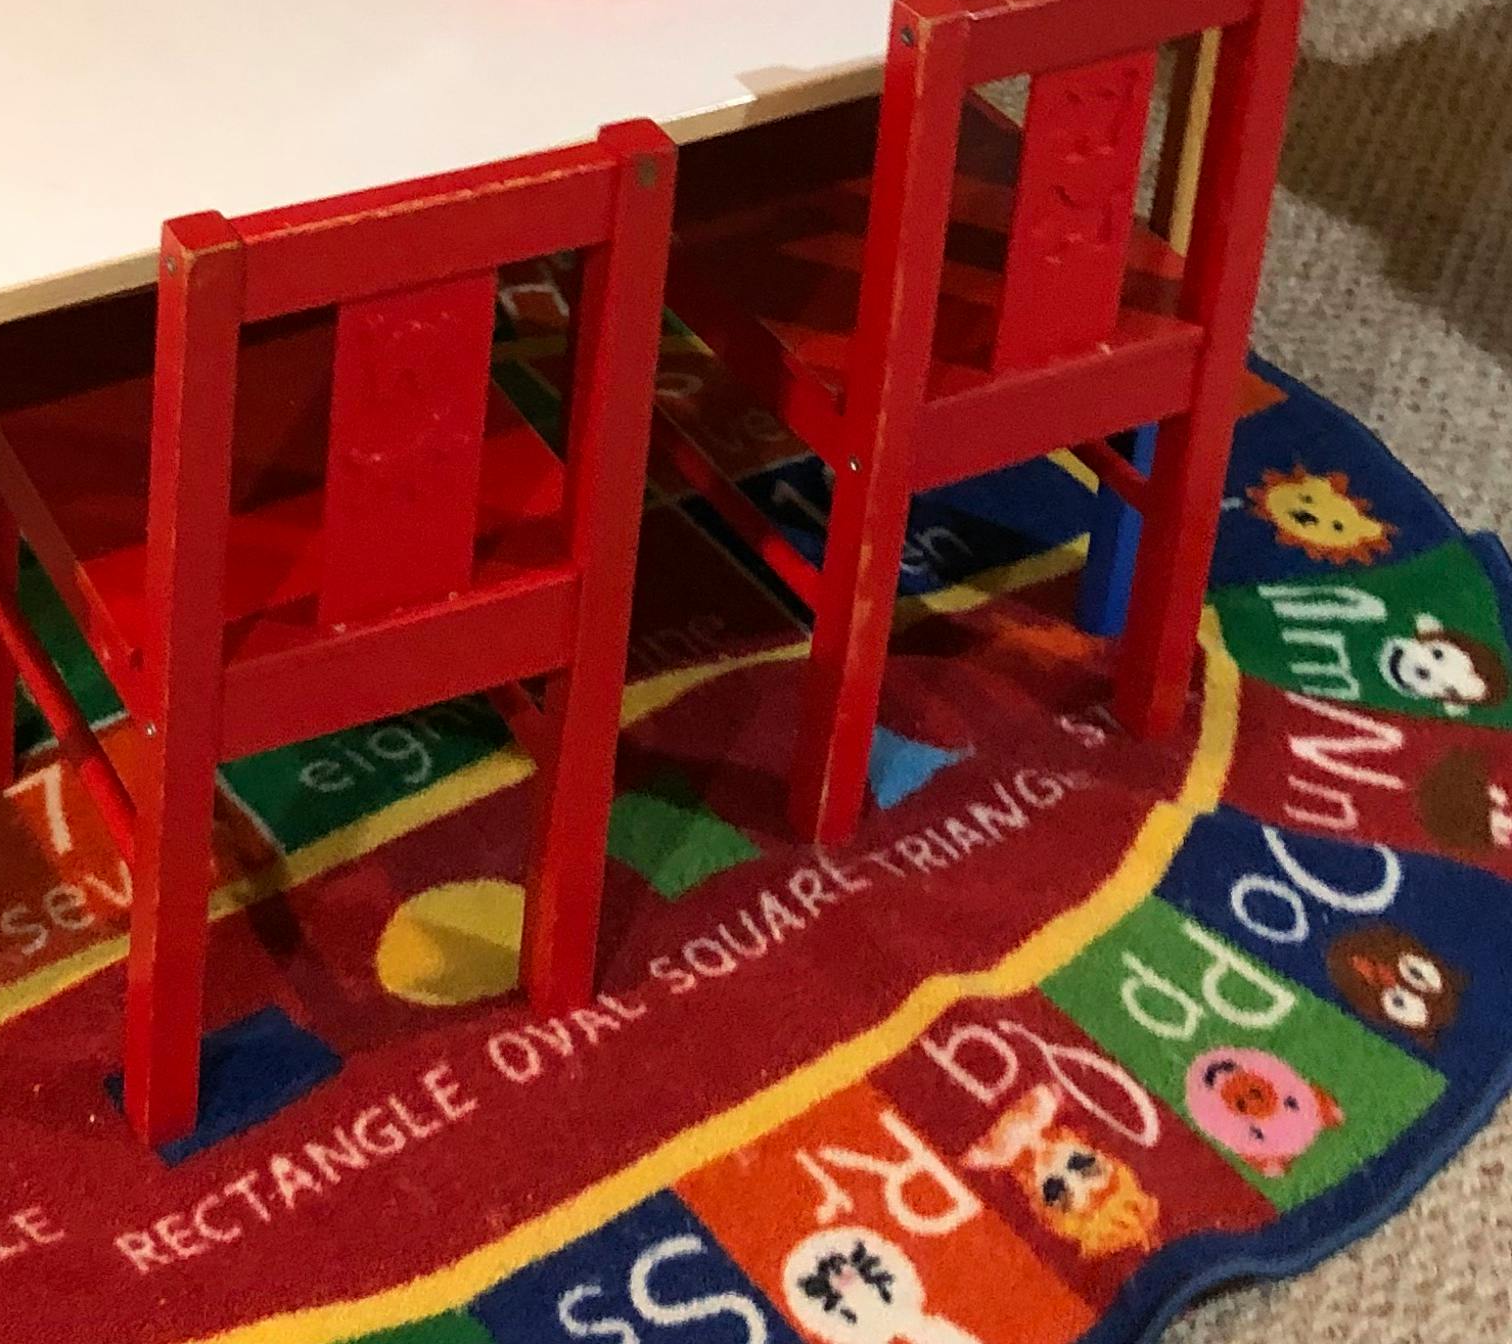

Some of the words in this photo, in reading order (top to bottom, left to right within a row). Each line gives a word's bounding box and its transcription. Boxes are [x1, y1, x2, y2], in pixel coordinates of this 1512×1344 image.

[4, 764, 71, 856] 7
[1285, 689, 1405, 831] Nn
[1, 861, 133, 955] sev
[115, 1063, 479, 1274] RECTANGLE
[487, 992, 648, 1085] OVAL
[649, 849, 872, 993] SQUARE
[868, 768, 1091, 879] TRIANG
[1120, 917, 1296, 1040] Pp
[795, 1109, 983, 1237] Rr
